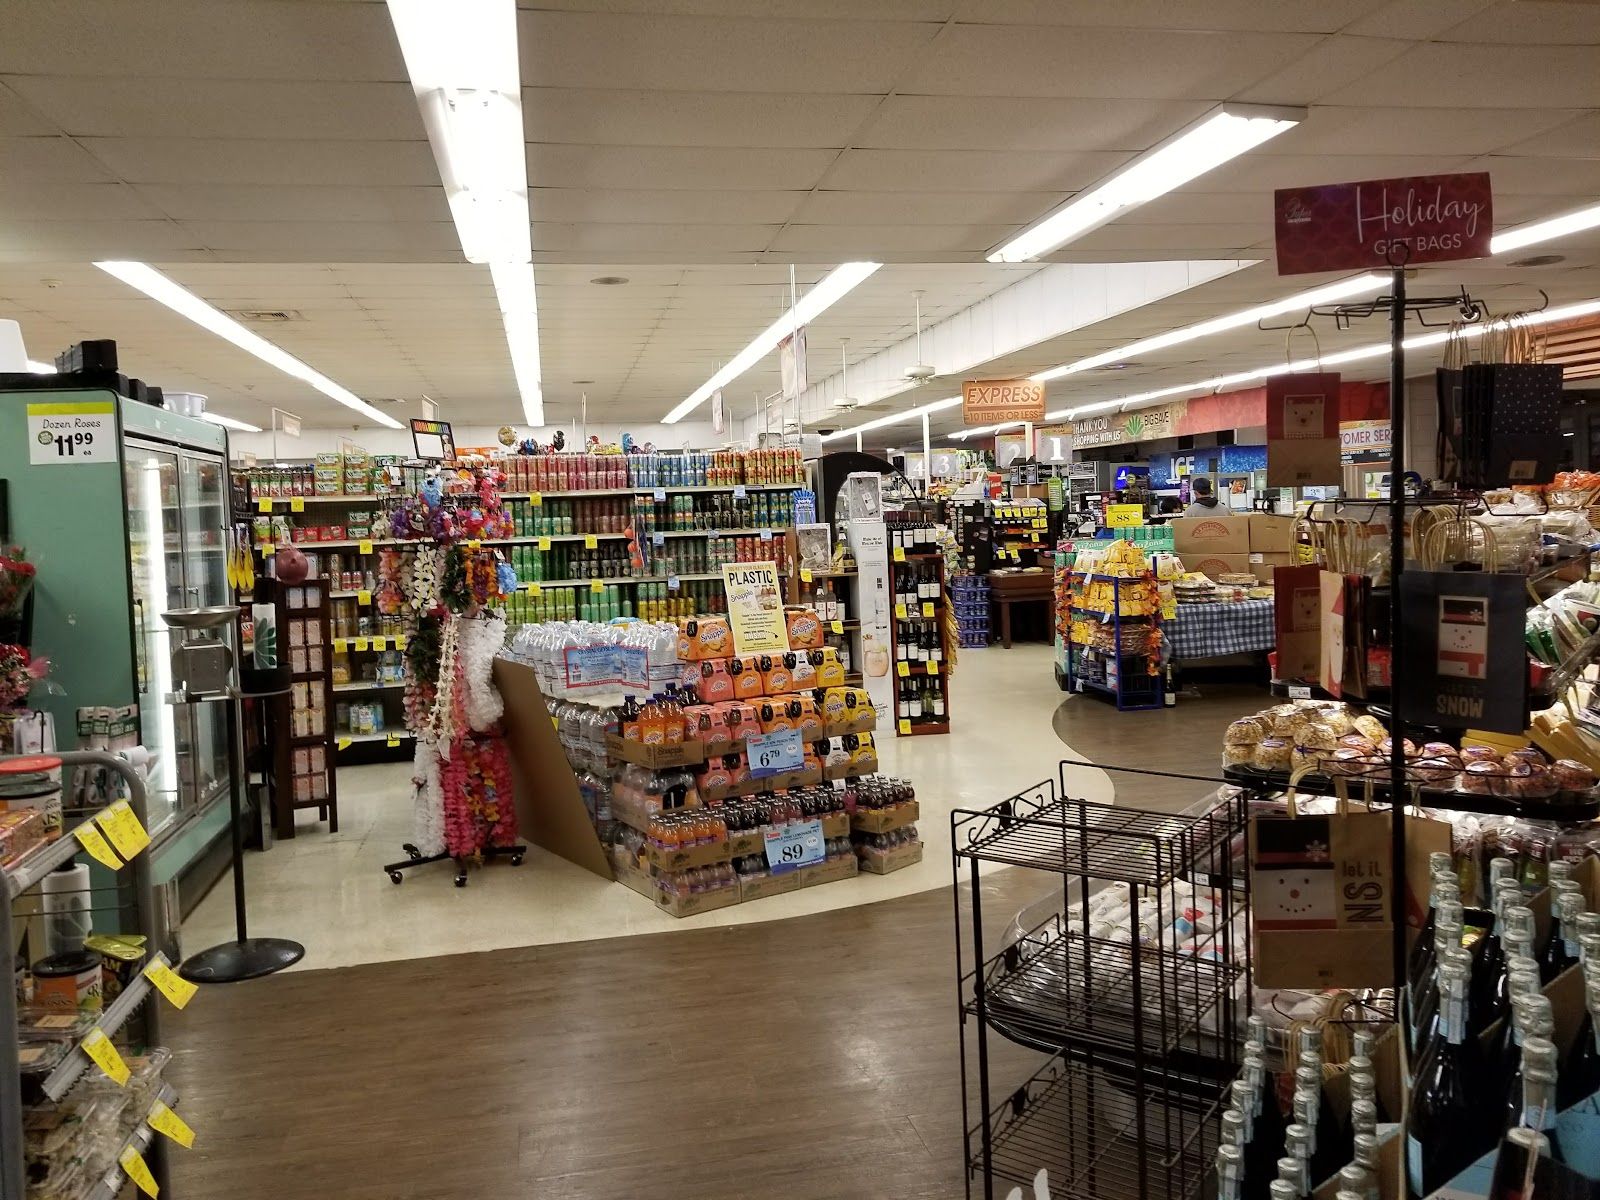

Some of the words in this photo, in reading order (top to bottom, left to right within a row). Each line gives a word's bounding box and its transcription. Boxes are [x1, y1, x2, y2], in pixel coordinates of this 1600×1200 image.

[1356, 183, 1485, 243] Holiday
[1417, 233, 1462, 251] BAGS
[967, 386, 1041, 404] EXPRESS
[43, 419, 71, 429] Dozen
[74, 418, 101, 428] Roses
[970, 412, 980, 421] 10
[981, 411, 1005, 421] ITEMS
[1006, 411, 1020, 420] OR
[1021, 410, 1039, 419] LESS
[1073, 419, 1094, 434] THANK
[1094, 418, 1108, 430] YOU
[1073, 433, 1099, 446] SHOPPING
[1100, 431, 1113, 443] WITH
[1113, 430, 1121, 441] US
[1050, 437, 1064, 460] 1
[913, 459, 925, 477] 4
[938, 455, 950, 474] 3
[728, 570, 774, 586] PLASTIC
[730, 589, 754, 602] Snapple
[701, 627, 726, 643] Snapple
[791, 620, 817, 636] Snapple
[1436, 694, 1484, 718] SNOW
[778, 843, 803, 864] .89
